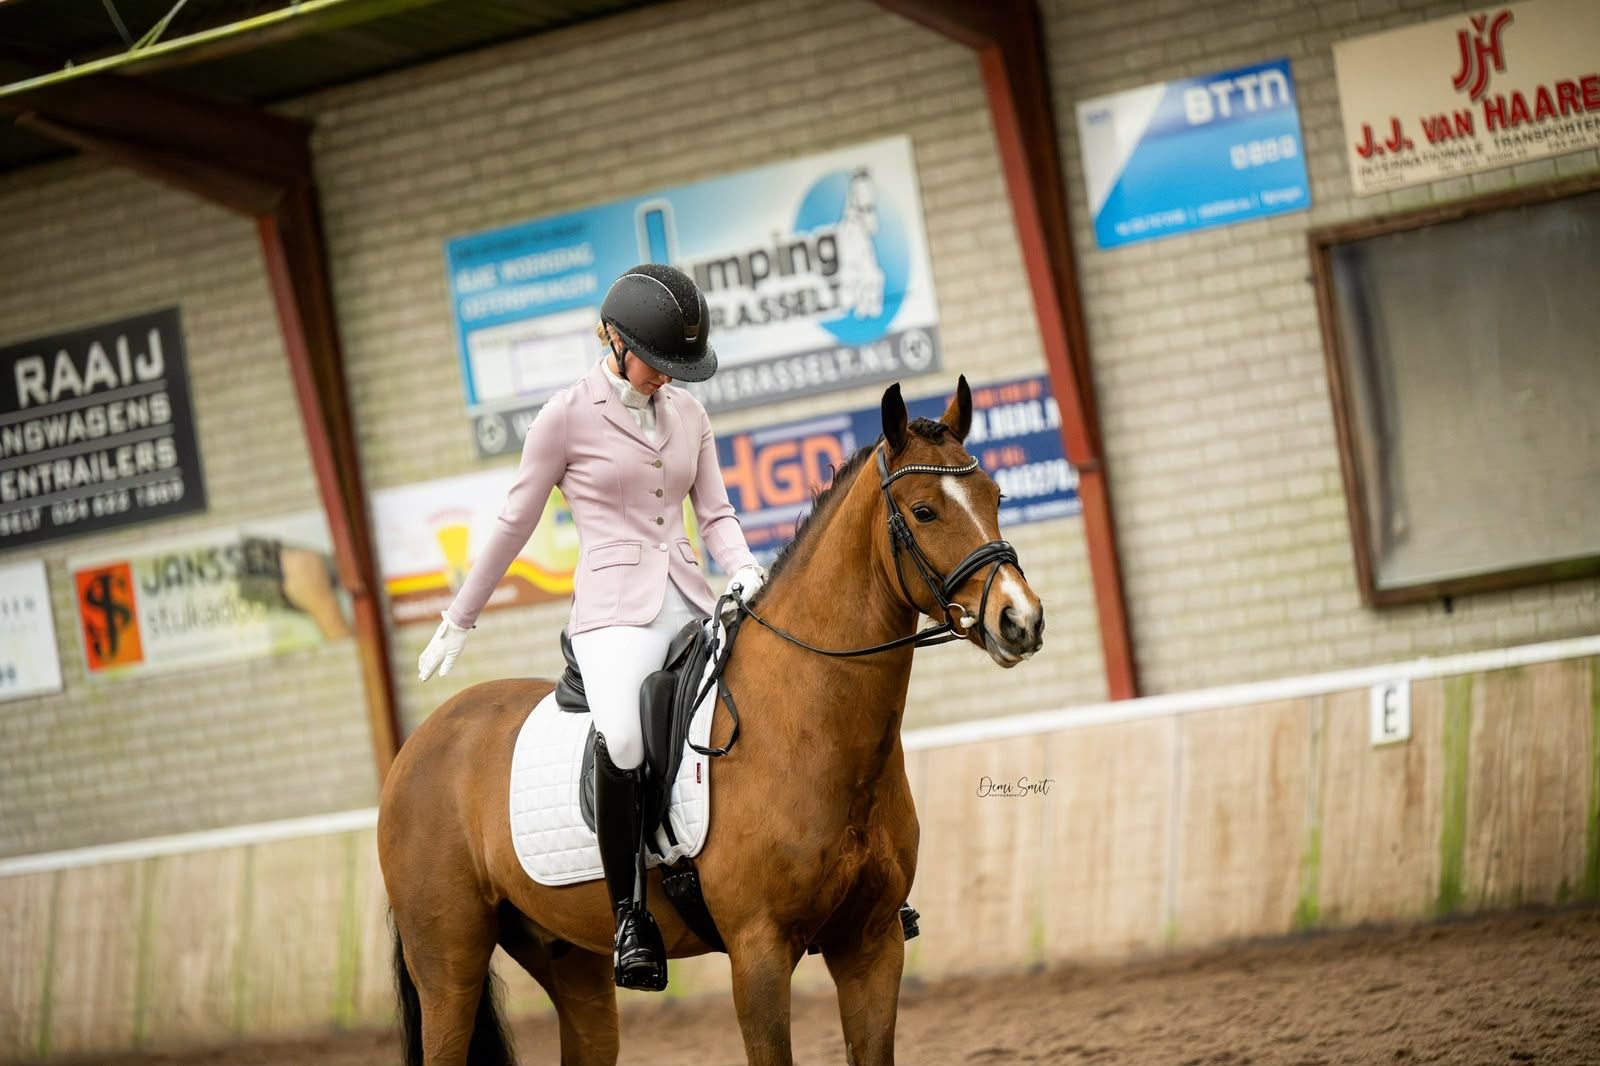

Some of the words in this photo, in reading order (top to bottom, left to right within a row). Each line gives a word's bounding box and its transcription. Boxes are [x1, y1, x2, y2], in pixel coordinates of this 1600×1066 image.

[1421, 110, 1475, 146] VAN
[14, 328, 165, 408] RAAIJ
[0, 437, 177, 502] ENTRAILERS
[1383, 687, 1398, 734] E
